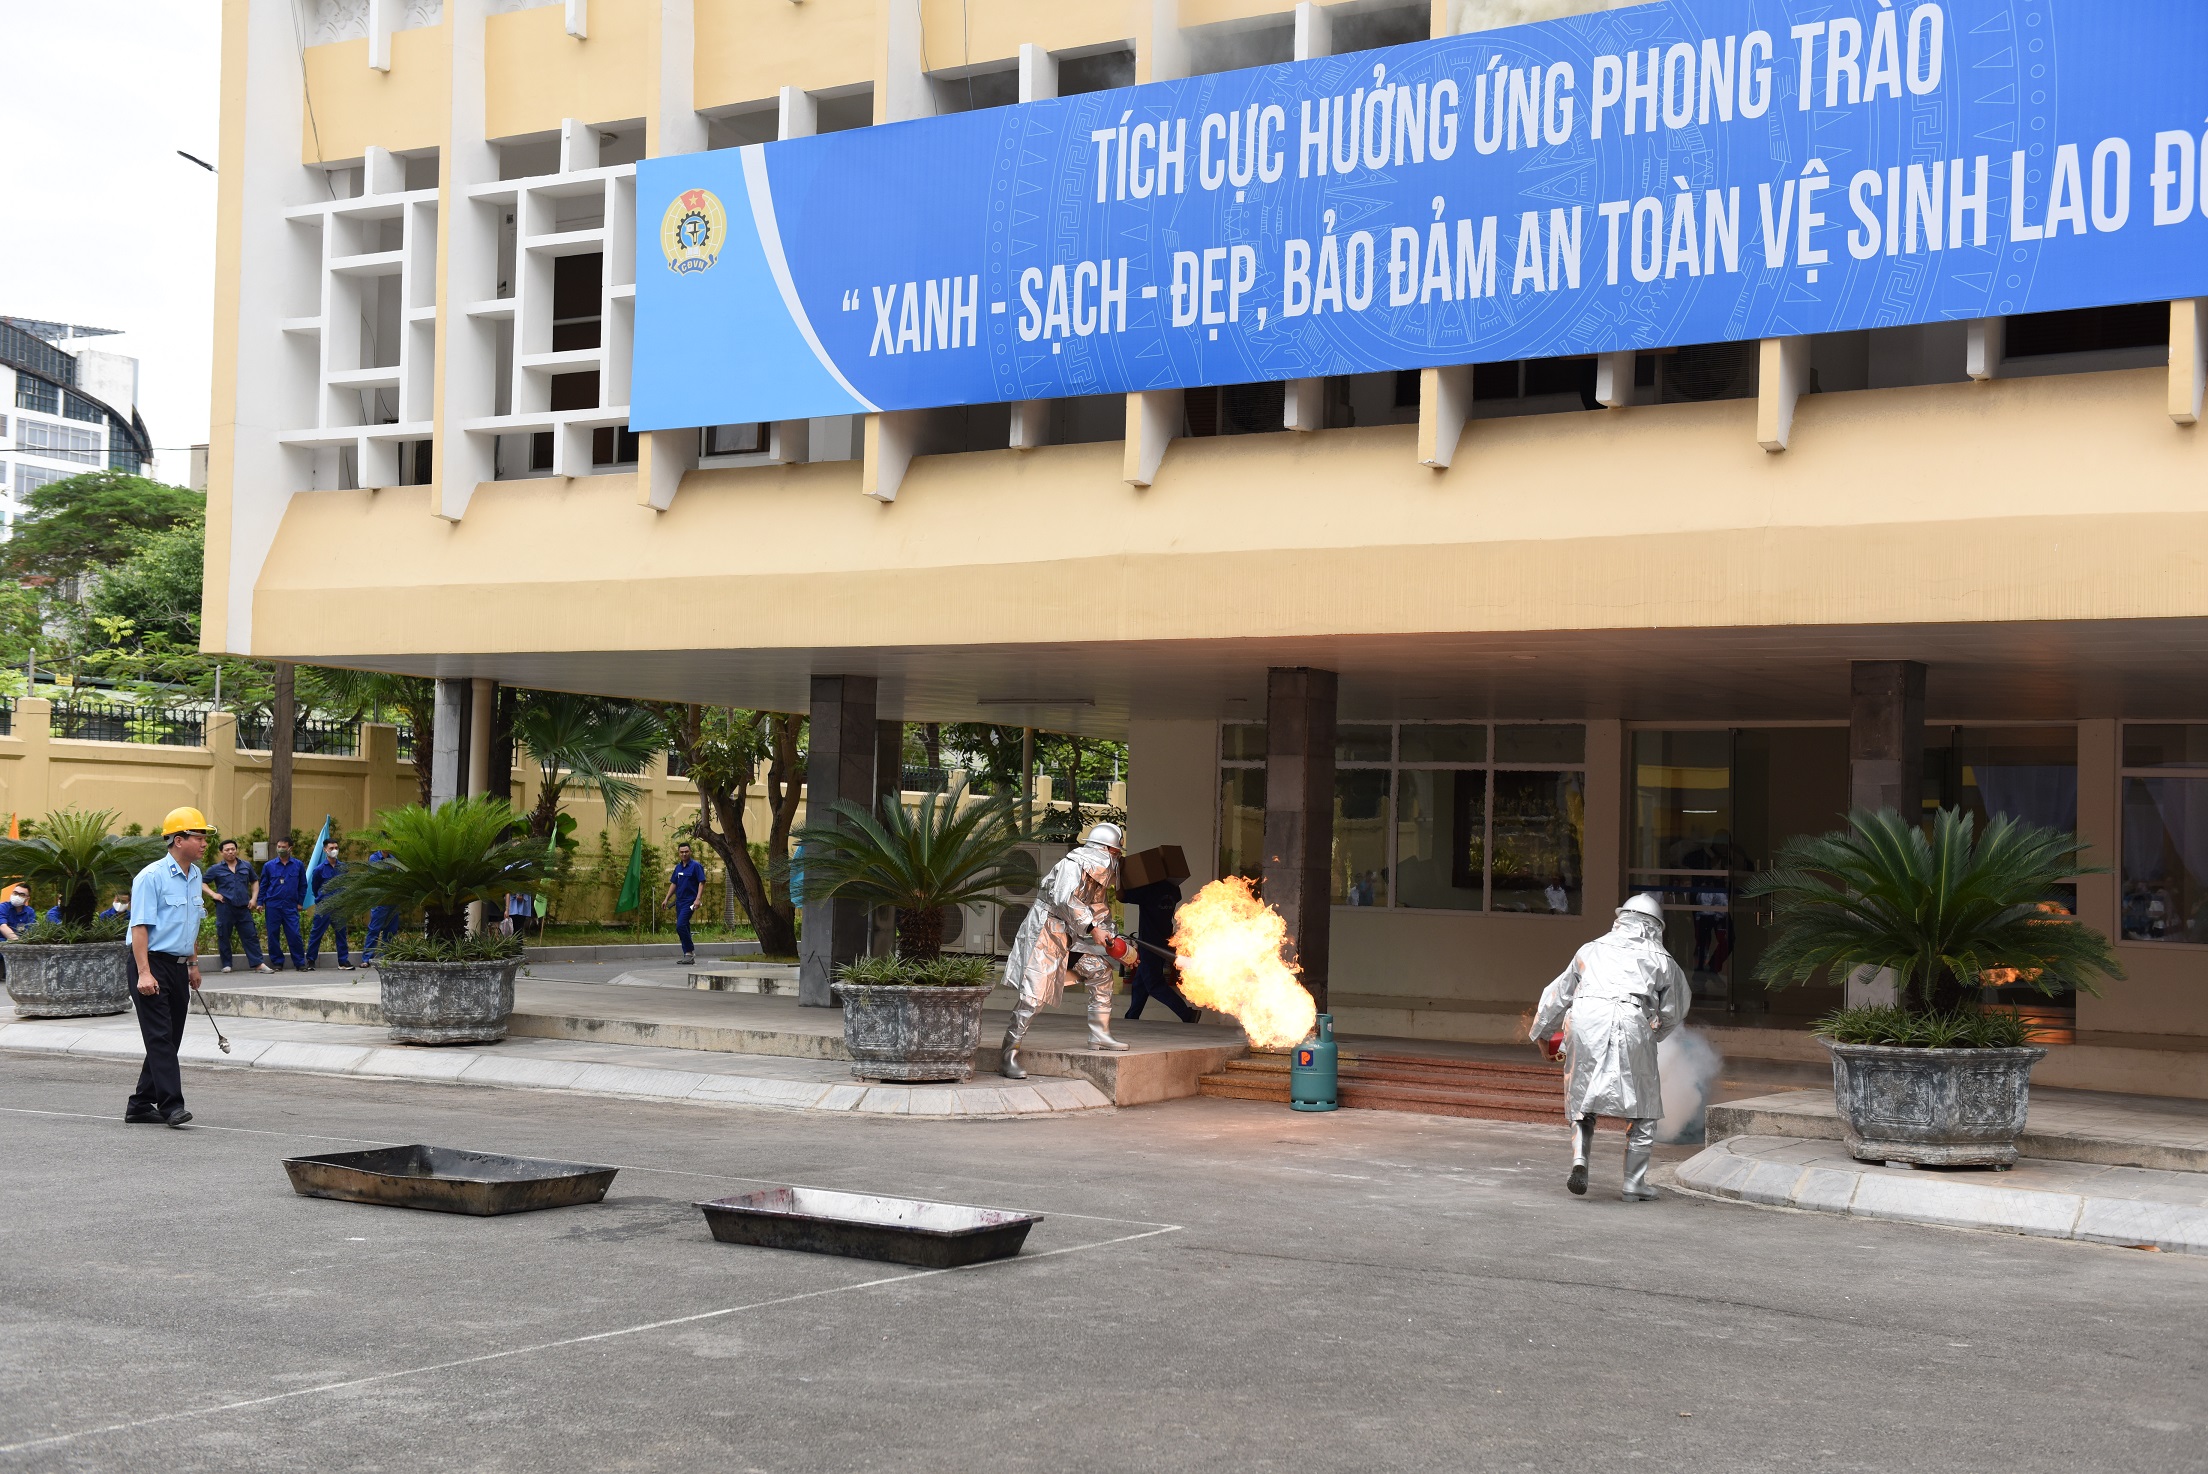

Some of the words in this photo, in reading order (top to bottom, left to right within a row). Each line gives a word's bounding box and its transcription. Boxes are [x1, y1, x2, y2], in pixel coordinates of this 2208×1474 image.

[1092, 110, 1186, 203] TÍCH
[1199, 103, 1285, 205] CỰC
[1299, 62, 1459, 179] HƯỞNG
[1474, 54, 1575, 154] ỨNG
[1591, 30, 1773, 140] PHONG
[1791, 0, 1944, 111] TRÀO
[1018, 258, 1128, 355] SẠCH
[1171, 245, 1267, 342] ĐẸP,
[1283, 209, 1375, 317] BẢO
[1387, 195, 1498, 307] ĐẢM
[1511, 205, 1582, 295] AN
[1599, 176, 1740, 286] TOÀN
[1759, 158, 1830, 284] VỆ
[1847, 155, 1989, 269] SINH
[2010, 137, 2131, 243] LAO
[2150, 116, 2208, 227] Đ
